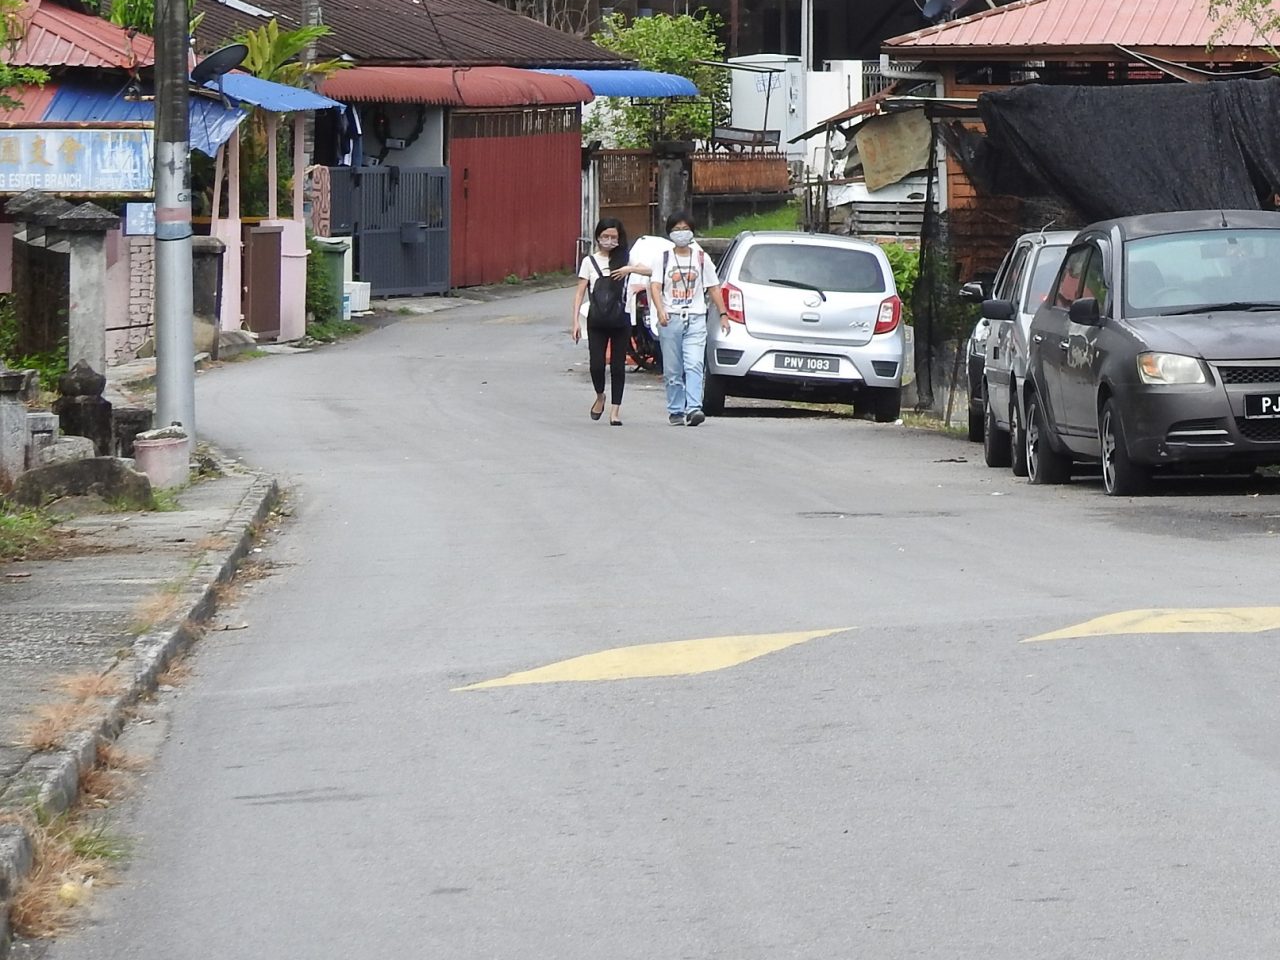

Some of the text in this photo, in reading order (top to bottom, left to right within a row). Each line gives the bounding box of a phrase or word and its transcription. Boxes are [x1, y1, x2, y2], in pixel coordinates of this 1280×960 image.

[9, 173, 41, 188] ESTATE
[44, 173, 82, 188] BRANCH
[783, 356, 830, 370] PNV 1083
